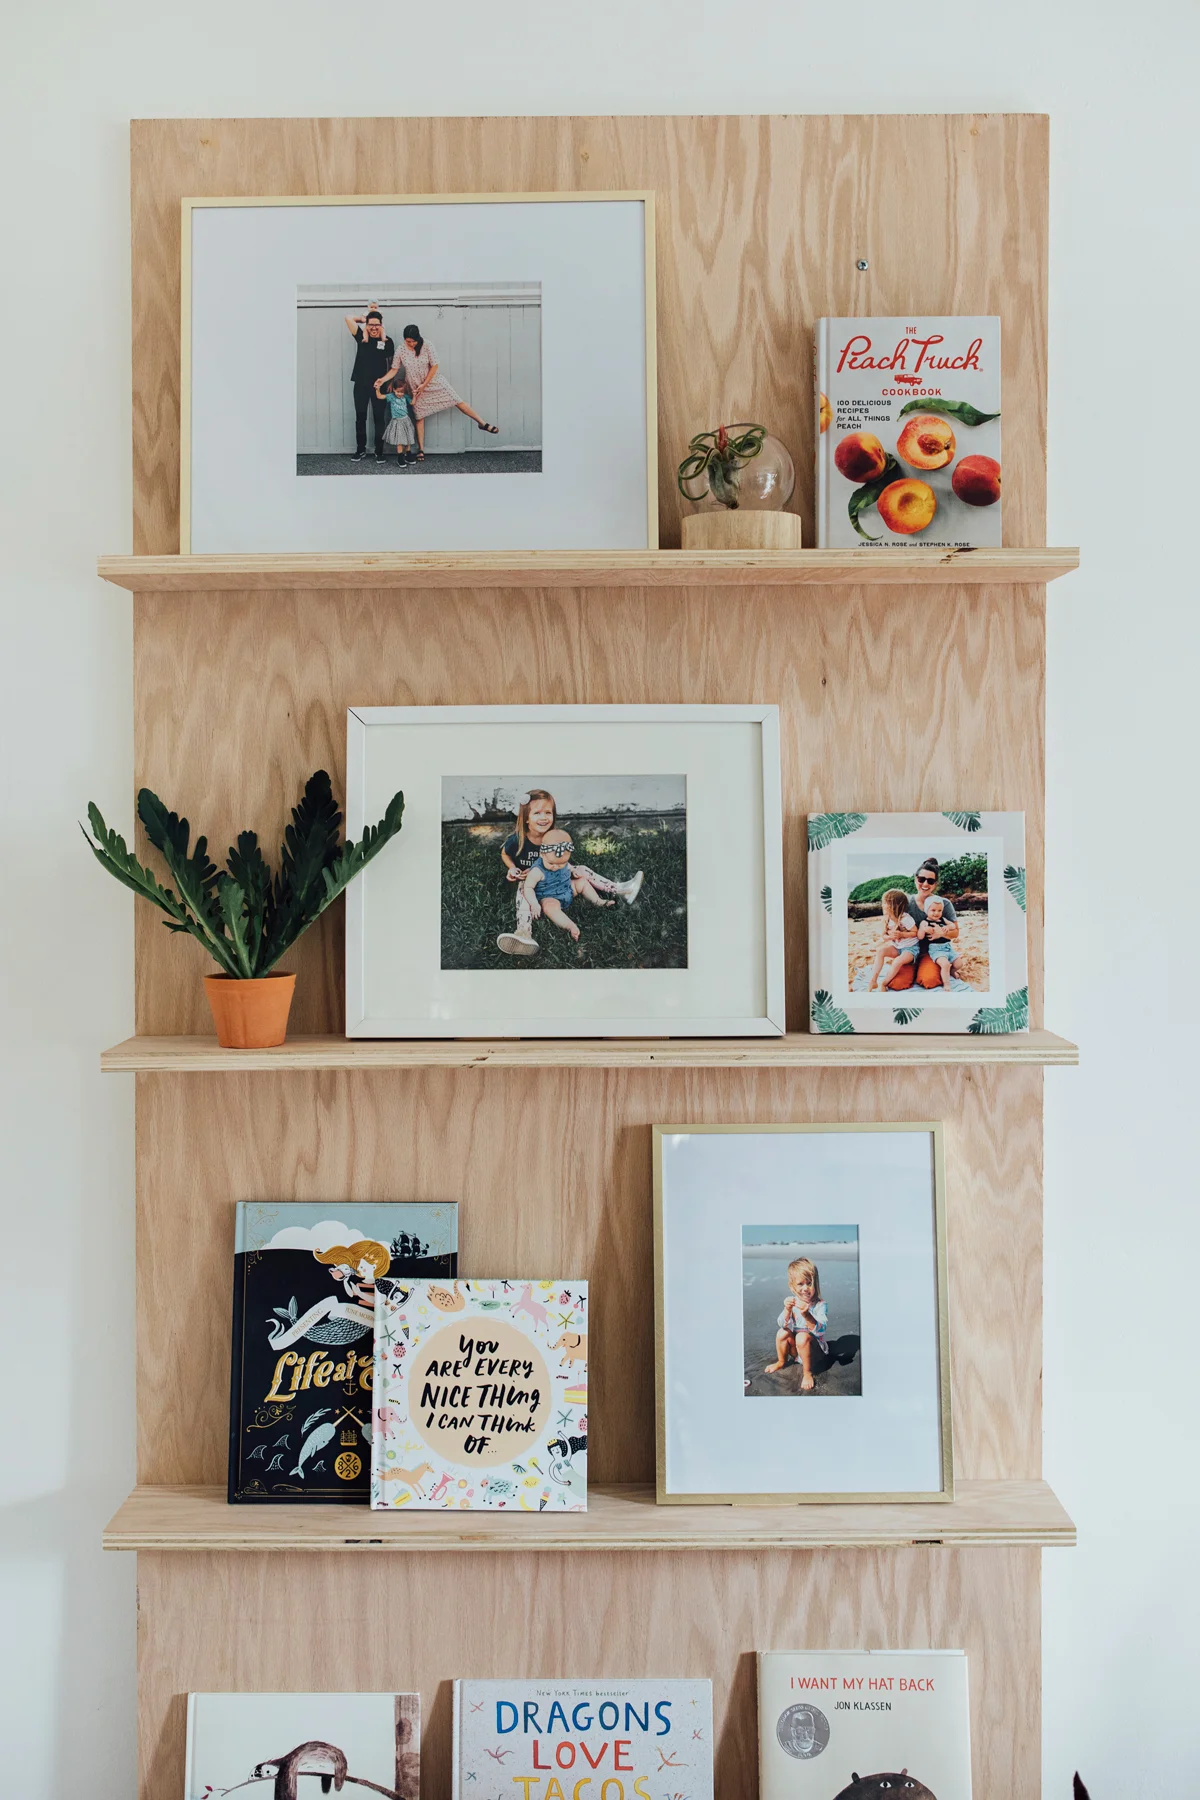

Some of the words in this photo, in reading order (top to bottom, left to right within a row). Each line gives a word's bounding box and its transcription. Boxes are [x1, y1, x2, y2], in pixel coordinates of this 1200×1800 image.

[905, 326, 917, 335] THE
[836, 335, 910, 374] Peach
[911, 334, 983, 374] Truck
[881, 388, 942, 396] COOKBOOK
[835, 415, 846, 424] for
[291, 1307, 324, 1337] PRESENTING
[459, 1334, 500, 1369] you
[264, 1351, 335, 1403] Life
[332, 1350, 358, 1382] at
[425, 1360, 463, 1377] ARE
[420, 1382, 473, 1409] NICE
[425, 1412, 435, 1429] I
[437, 1413, 475, 1430] CAN
[790, 1676, 795, 1689] I
[797, 1677, 838, 1690] WANT
[842, 1677, 865, 1690] MY
[868, 1677, 895, 1691] HAT
[899, 1678, 936, 1691] BACK
[834, 1701, 851, 1710] JON
[853, 1701, 892, 1711] KLASSEN
[496, 1701, 672, 1736] DRAGONS
[533, 1740, 634, 1771] LOVE
[512, 1776, 651, 1800] TACOS
